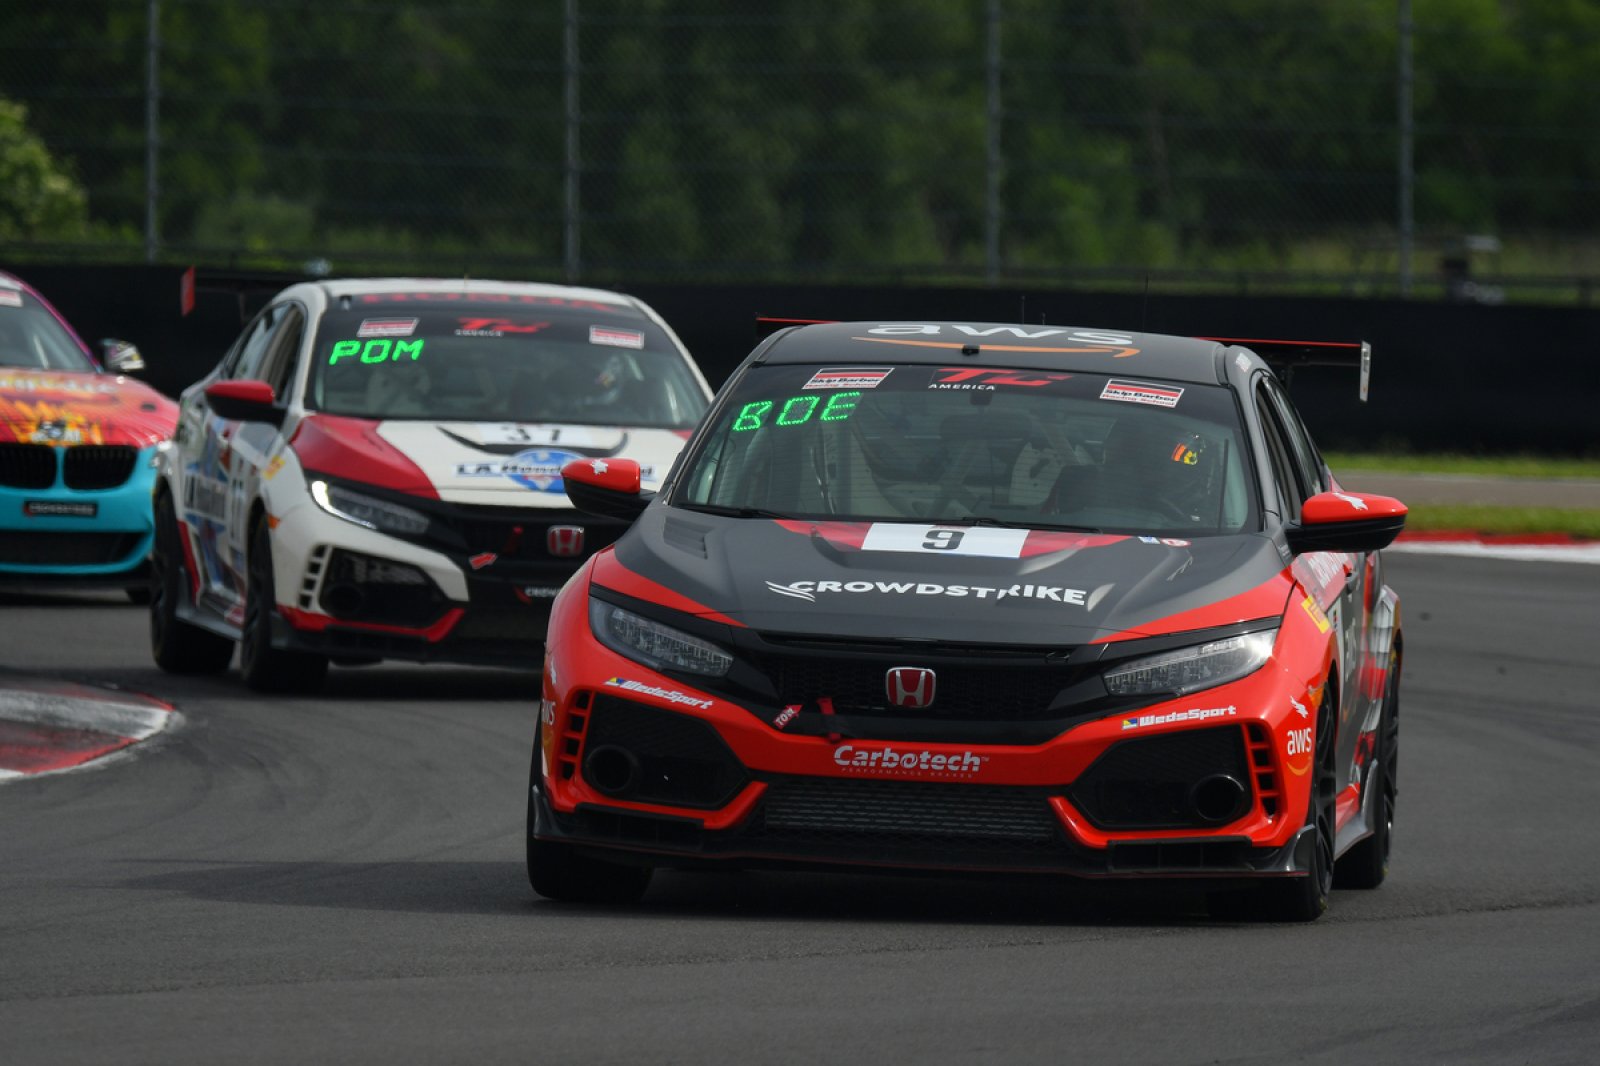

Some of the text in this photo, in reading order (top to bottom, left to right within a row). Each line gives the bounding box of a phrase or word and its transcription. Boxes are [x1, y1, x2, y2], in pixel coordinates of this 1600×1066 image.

[868, 324, 1133, 345] aws
[328, 339, 425, 365] POM
[928, 383, 996, 391] AMERICA
[1105, 388, 1176, 402] Skip Barber
[732, 391, 861, 431] BOE
[922, 529, 966, 551] 9
[786, 580, 1087, 606] CROWDSTRIKE
[620, 680, 714, 709] WedsSport
[775, 707, 795, 726] TOW
[1139, 705, 1237, 727] WedsSport
[1287, 727, 1313, 756] aws
[834, 745, 981, 772] Carbotech
[841, 767, 922, 777] PERFORMANCE
